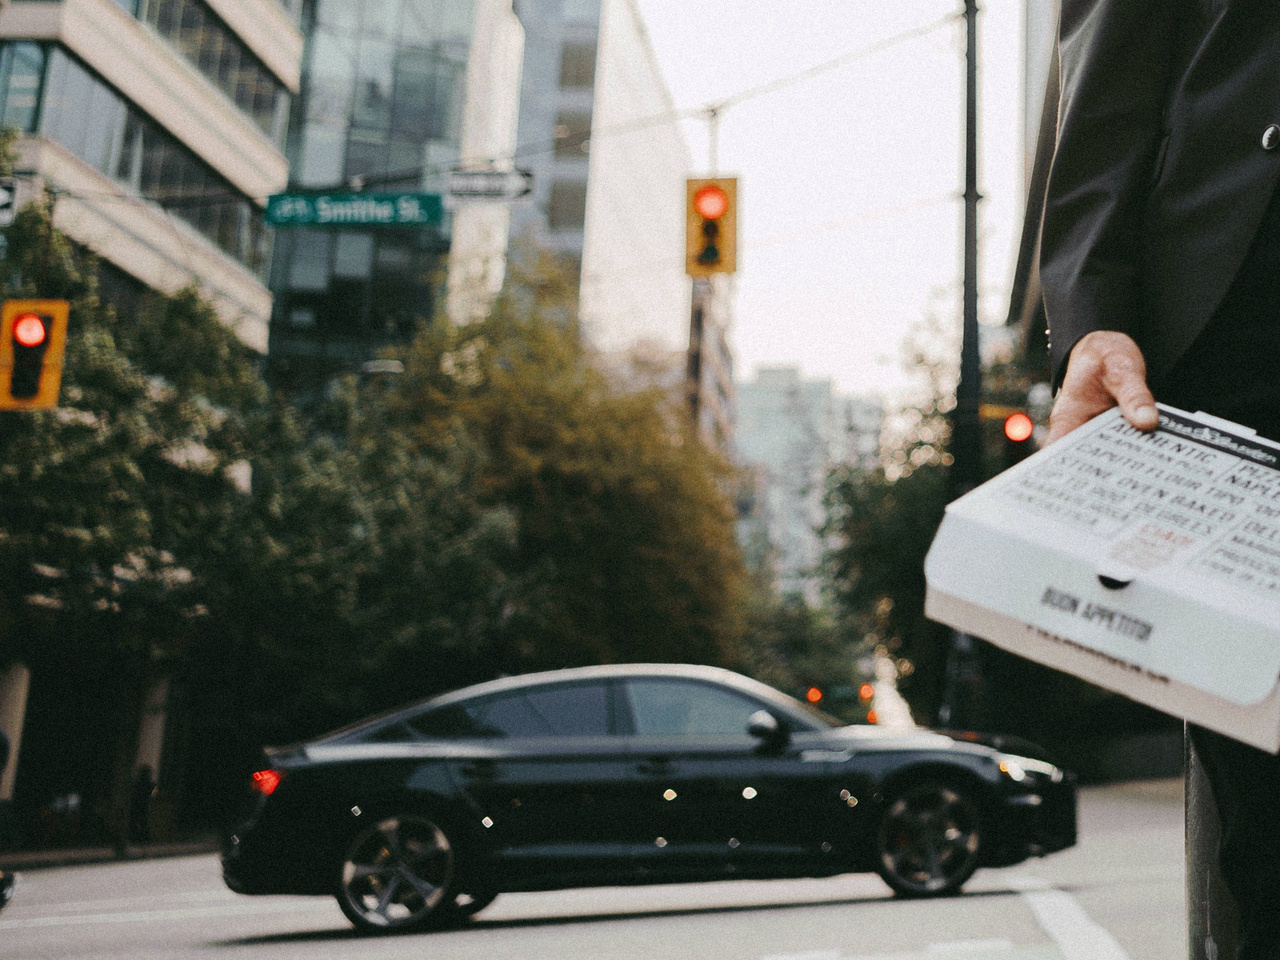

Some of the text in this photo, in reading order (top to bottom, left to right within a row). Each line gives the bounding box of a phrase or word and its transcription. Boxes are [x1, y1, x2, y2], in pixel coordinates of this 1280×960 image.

[316, 196, 393, 222] Smithe
[1054, 455, 1234, 522] STONE OVEN BAKED
[1076, 443, 1144, 469] CAPUTO
[1145, 466, 1202, 490] FLOUR
